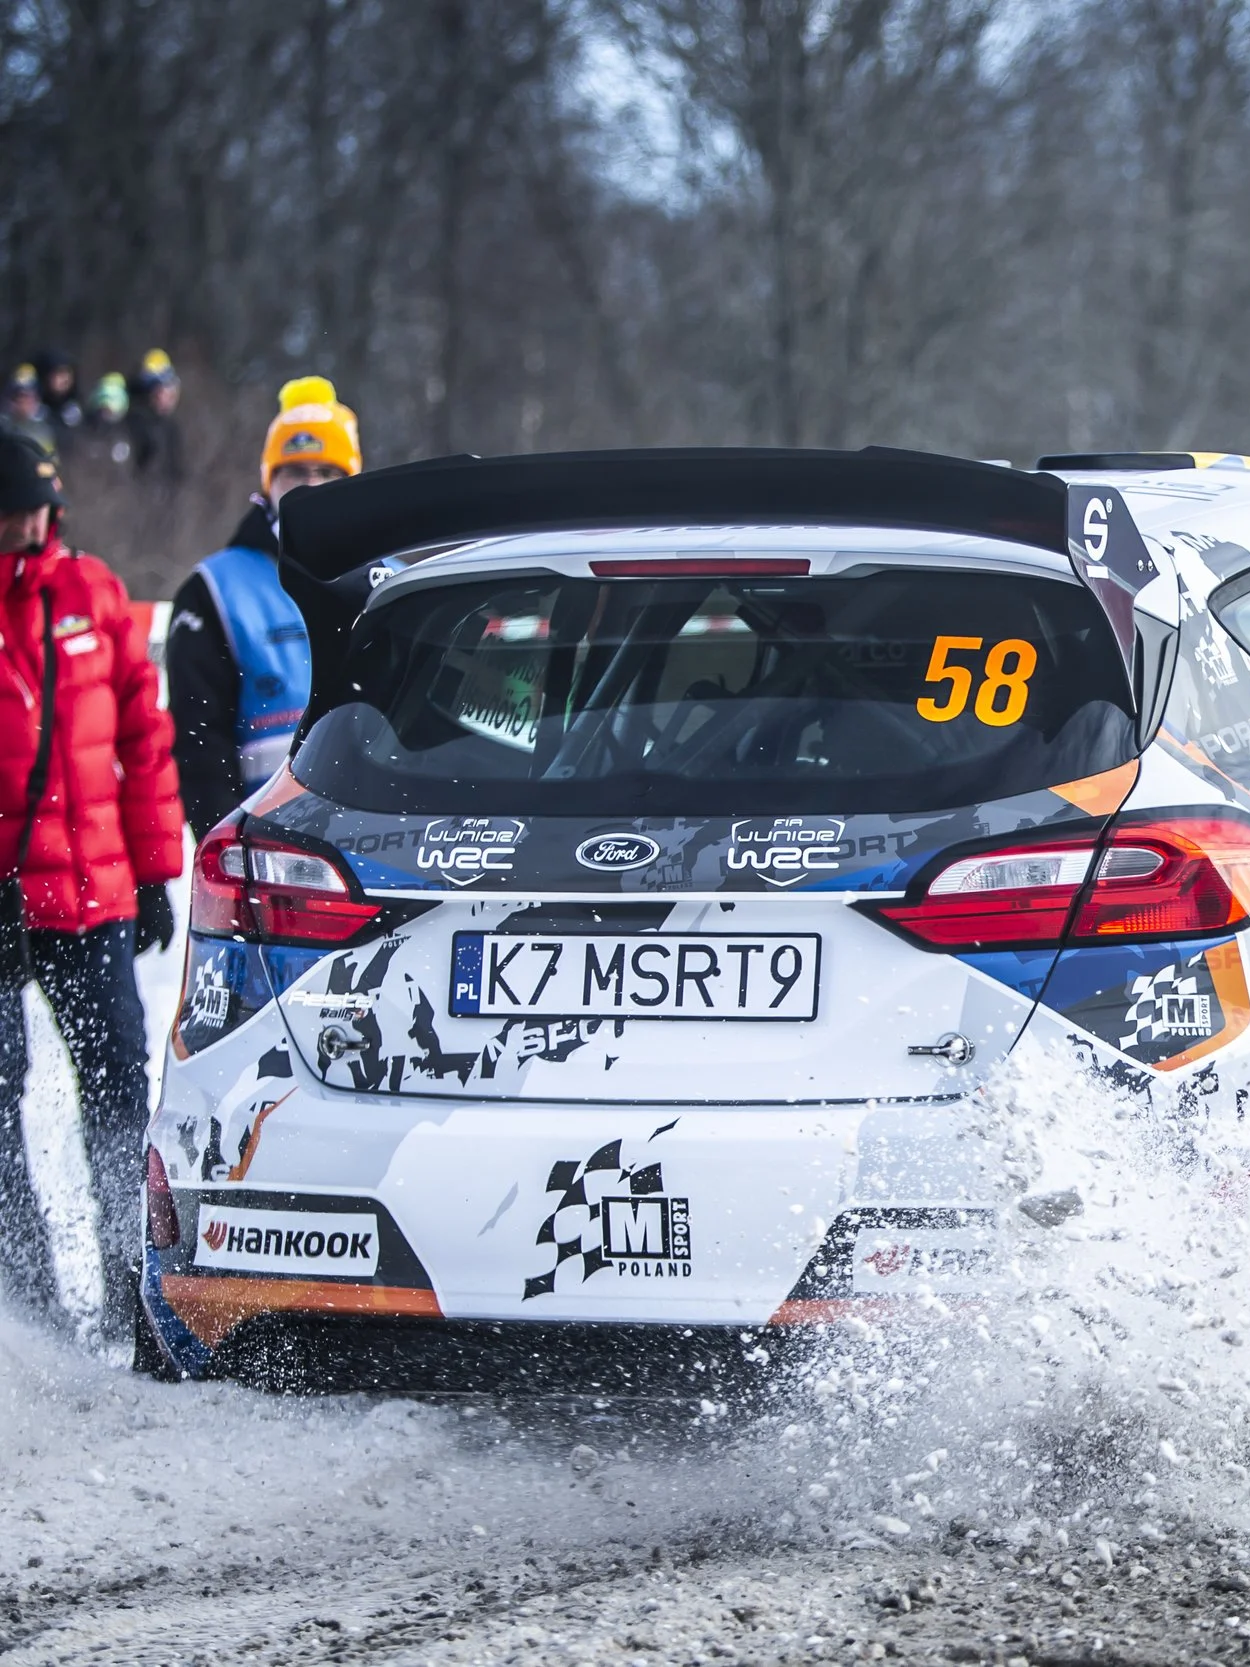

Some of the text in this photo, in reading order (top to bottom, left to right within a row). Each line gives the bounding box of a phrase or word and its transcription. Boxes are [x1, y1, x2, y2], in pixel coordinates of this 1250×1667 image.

[916, 635, 1037, 727] 58
[463, 819, 489, 828] FIA
[774, 818, 803, 828] FIA
[429, 830, 515, 843] JUNIOR
[737, 830, 835, 843] JUNIOR
[416, 846, 516, 870] WRC
[590, 840, 639, 863] Ford
[727, 846, 841, 870] WRC
[487, 942, 803, 1009] K7 MSRT9
[456, 983, 478, 1000] PL
[1167, 998, 1209, 1025] M SPORT
[1170, 1027, 1212, 1037] POLAND
[608, 1202, 688, 1256] M SPORT
[618, 1262, 692, 1278] POLAND
